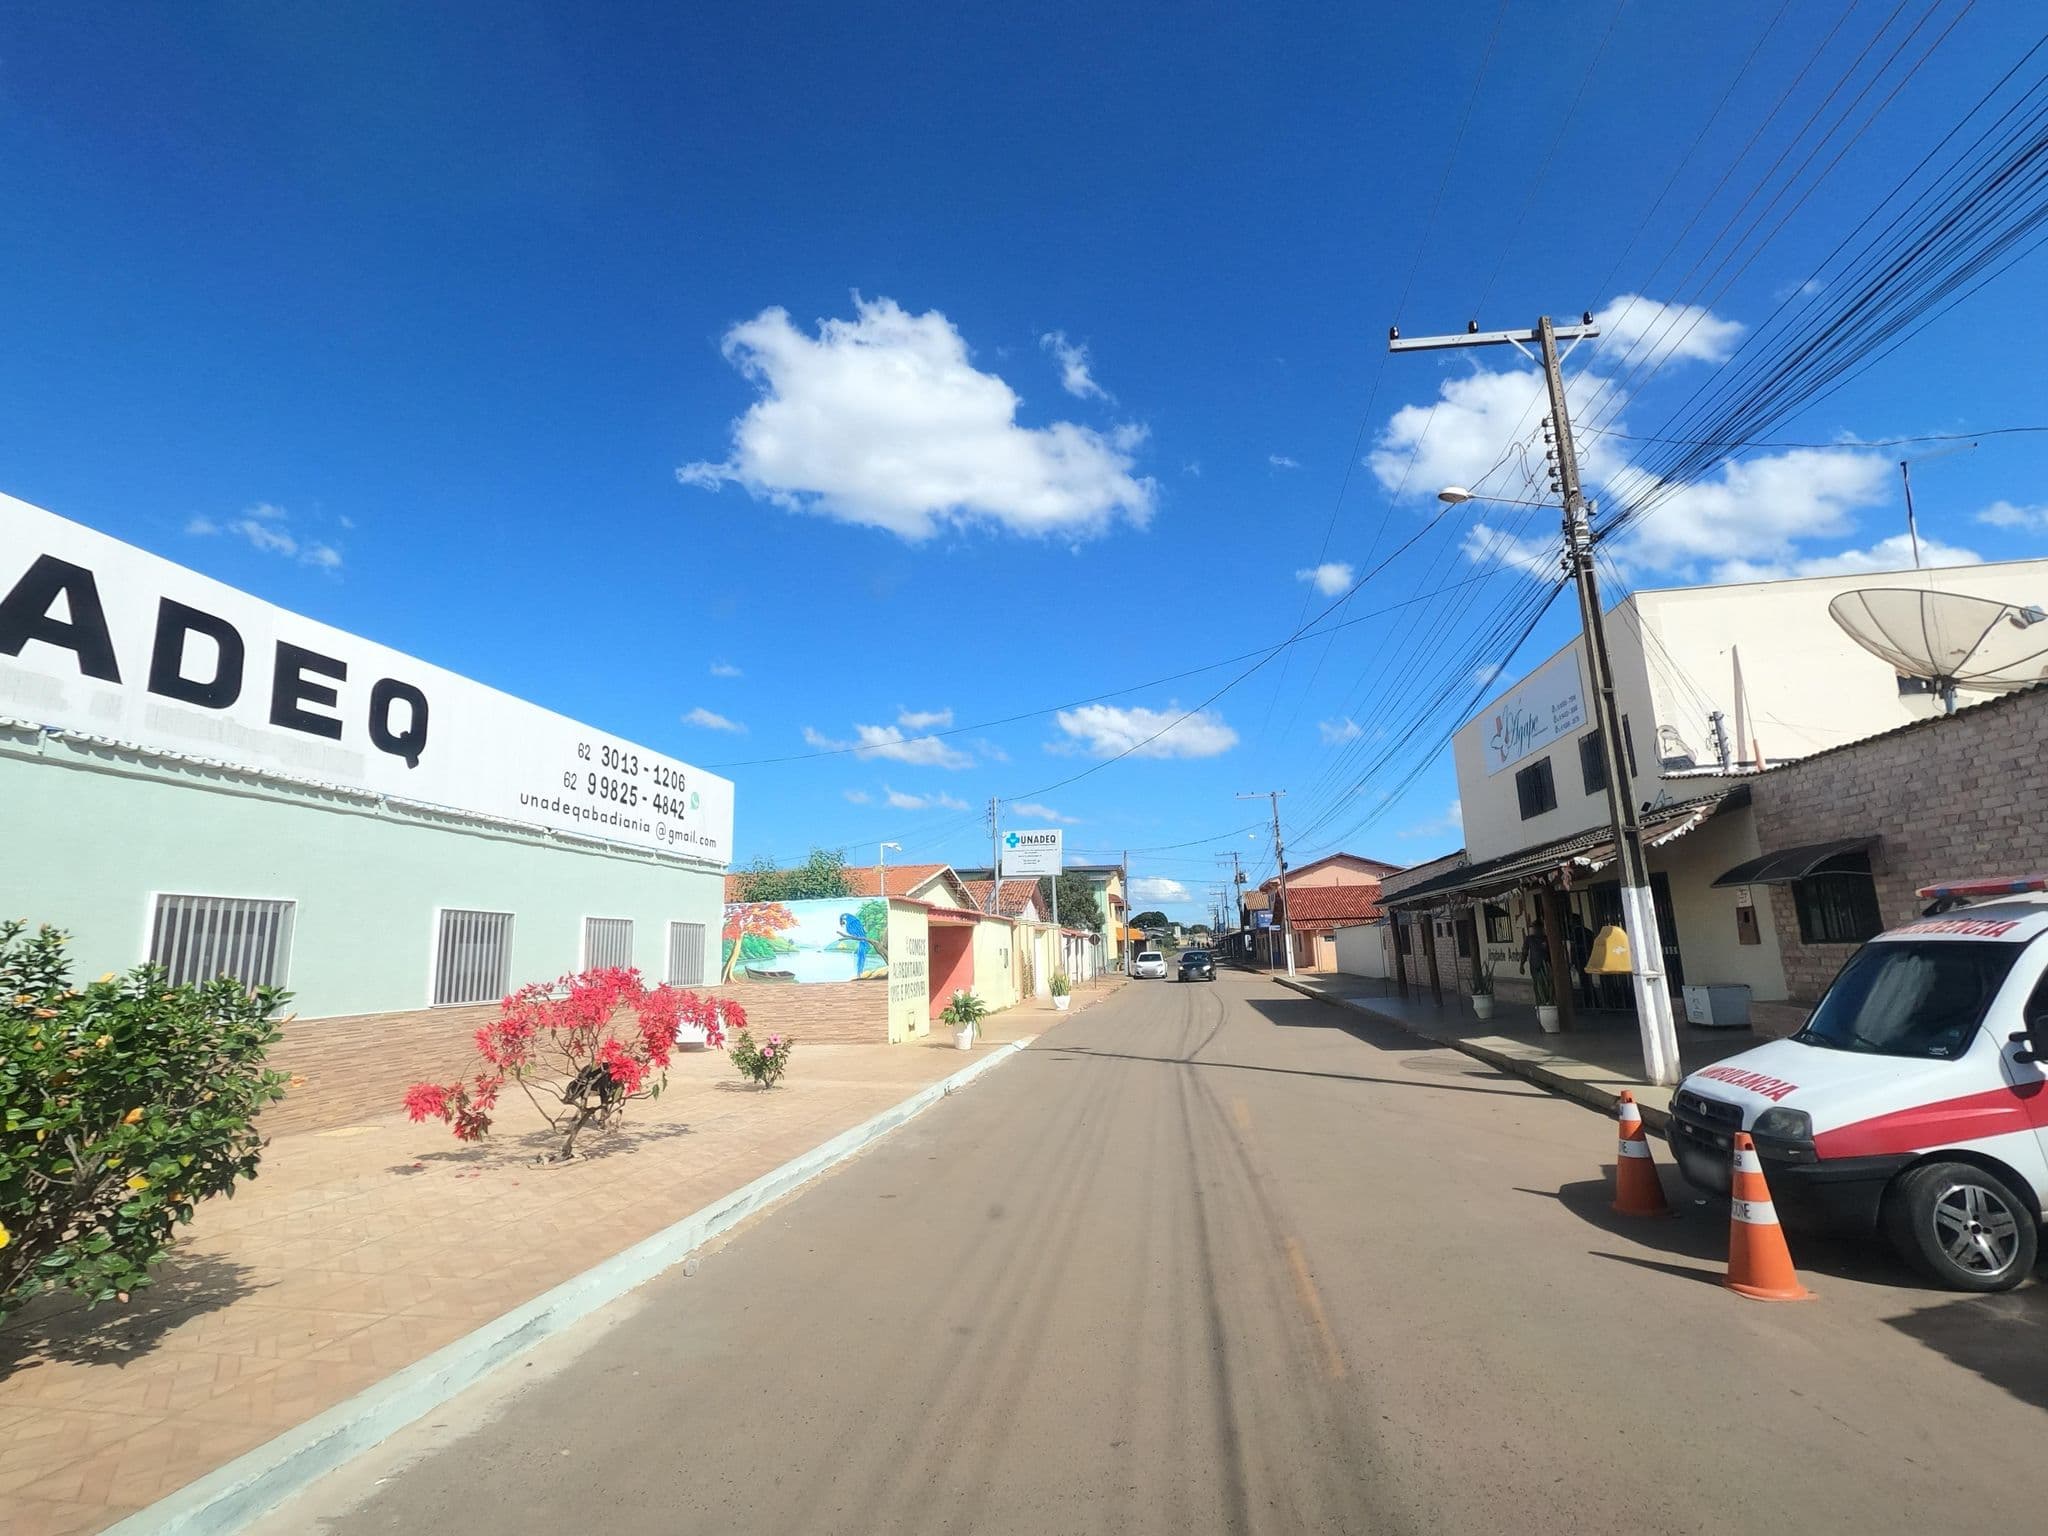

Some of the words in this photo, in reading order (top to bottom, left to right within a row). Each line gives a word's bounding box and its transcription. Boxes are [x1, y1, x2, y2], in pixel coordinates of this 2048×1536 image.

[577, 742, 591, 761] 62
[563, 771, 578, 790] 62
[1020, 834, 1056, 844] UNADEQ
